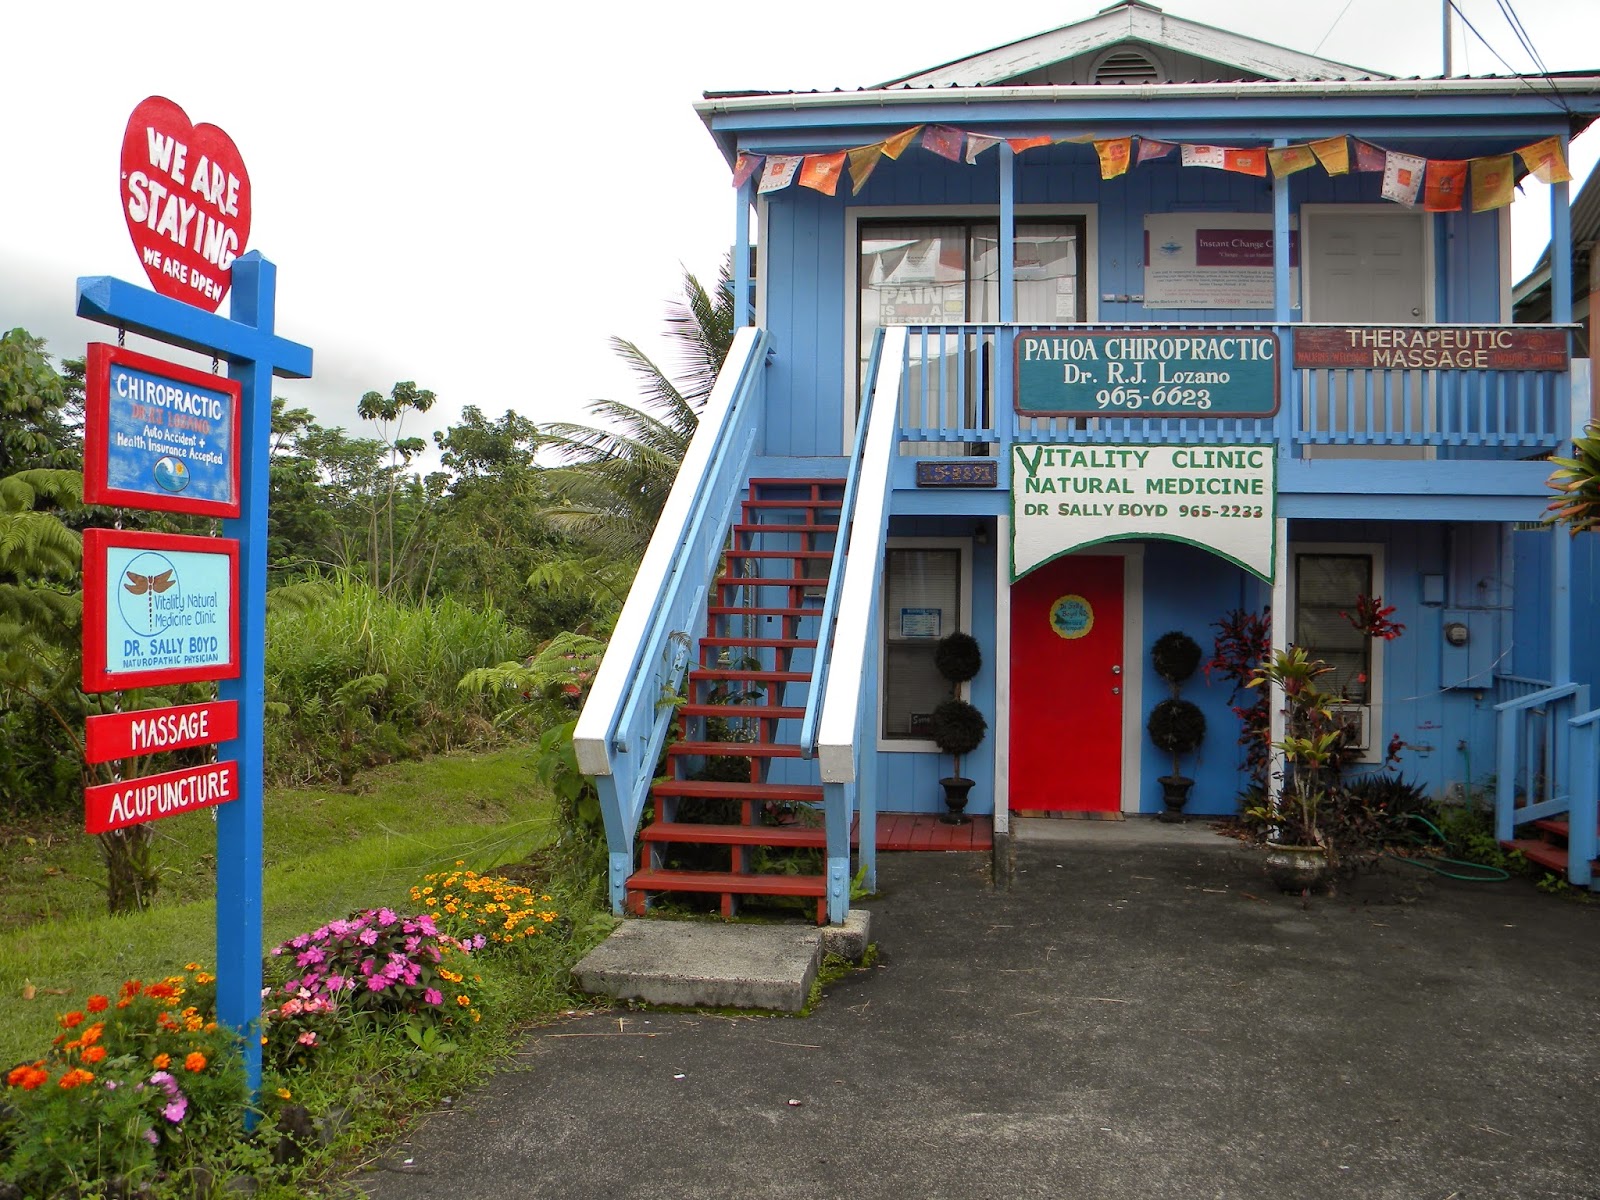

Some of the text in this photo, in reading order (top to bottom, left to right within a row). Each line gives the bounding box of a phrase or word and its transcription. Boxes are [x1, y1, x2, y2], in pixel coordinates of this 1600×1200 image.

[146, 127, 240, 218] WE ARE
[128, 171, 239, 271] STAYING
[1199, 239, 1229, 248] Instant
[1231, 238, 1264, 249] Change
[143, 246, 222, 302] WE ARE OPEN
[881, 287, 943, 304] PAIN
[881, 305, 895, 316] IS
[930, 305, 941, 316] A
[1024, 337, 1273, 361] PAHOA CHIROPRACTIC
[1345, 329, 1513, 349] THERAPEUTIC
[1372, 349, 1489, 368] MASSAGE
[1063, 362, 1230, 384] Dr. R.J. Lozano
[117, 373, 222, 421] CHIROPRACTIC
[1096, 386, 1212, 410] 965-6623
[143, 425, 163, 440] Auto
[164, 430, 197, 447] Accident
[117, 432, 223, 466] Health Insurance Accepted
[1015, 446, 1264, 478] VITALITY CLINIC
[1025, 477, 1264, 495] NATURAL MEDICINE
[1024, 503, 1263, 518] DR SALLY BOYD 965-2233
[154, 592, 218, 612] Vitality Natural
[155, 610, 217, 628] Medicine Clinic
[124, 636, 218, 657] DR. SALLY BOYD
[123, 653, 219, 668] NATUROPATHIC PHYSICIAN
[131, 709, 209, 751] MASSAGE
[109, 768, 230, 824] ACUPUNCTURE
